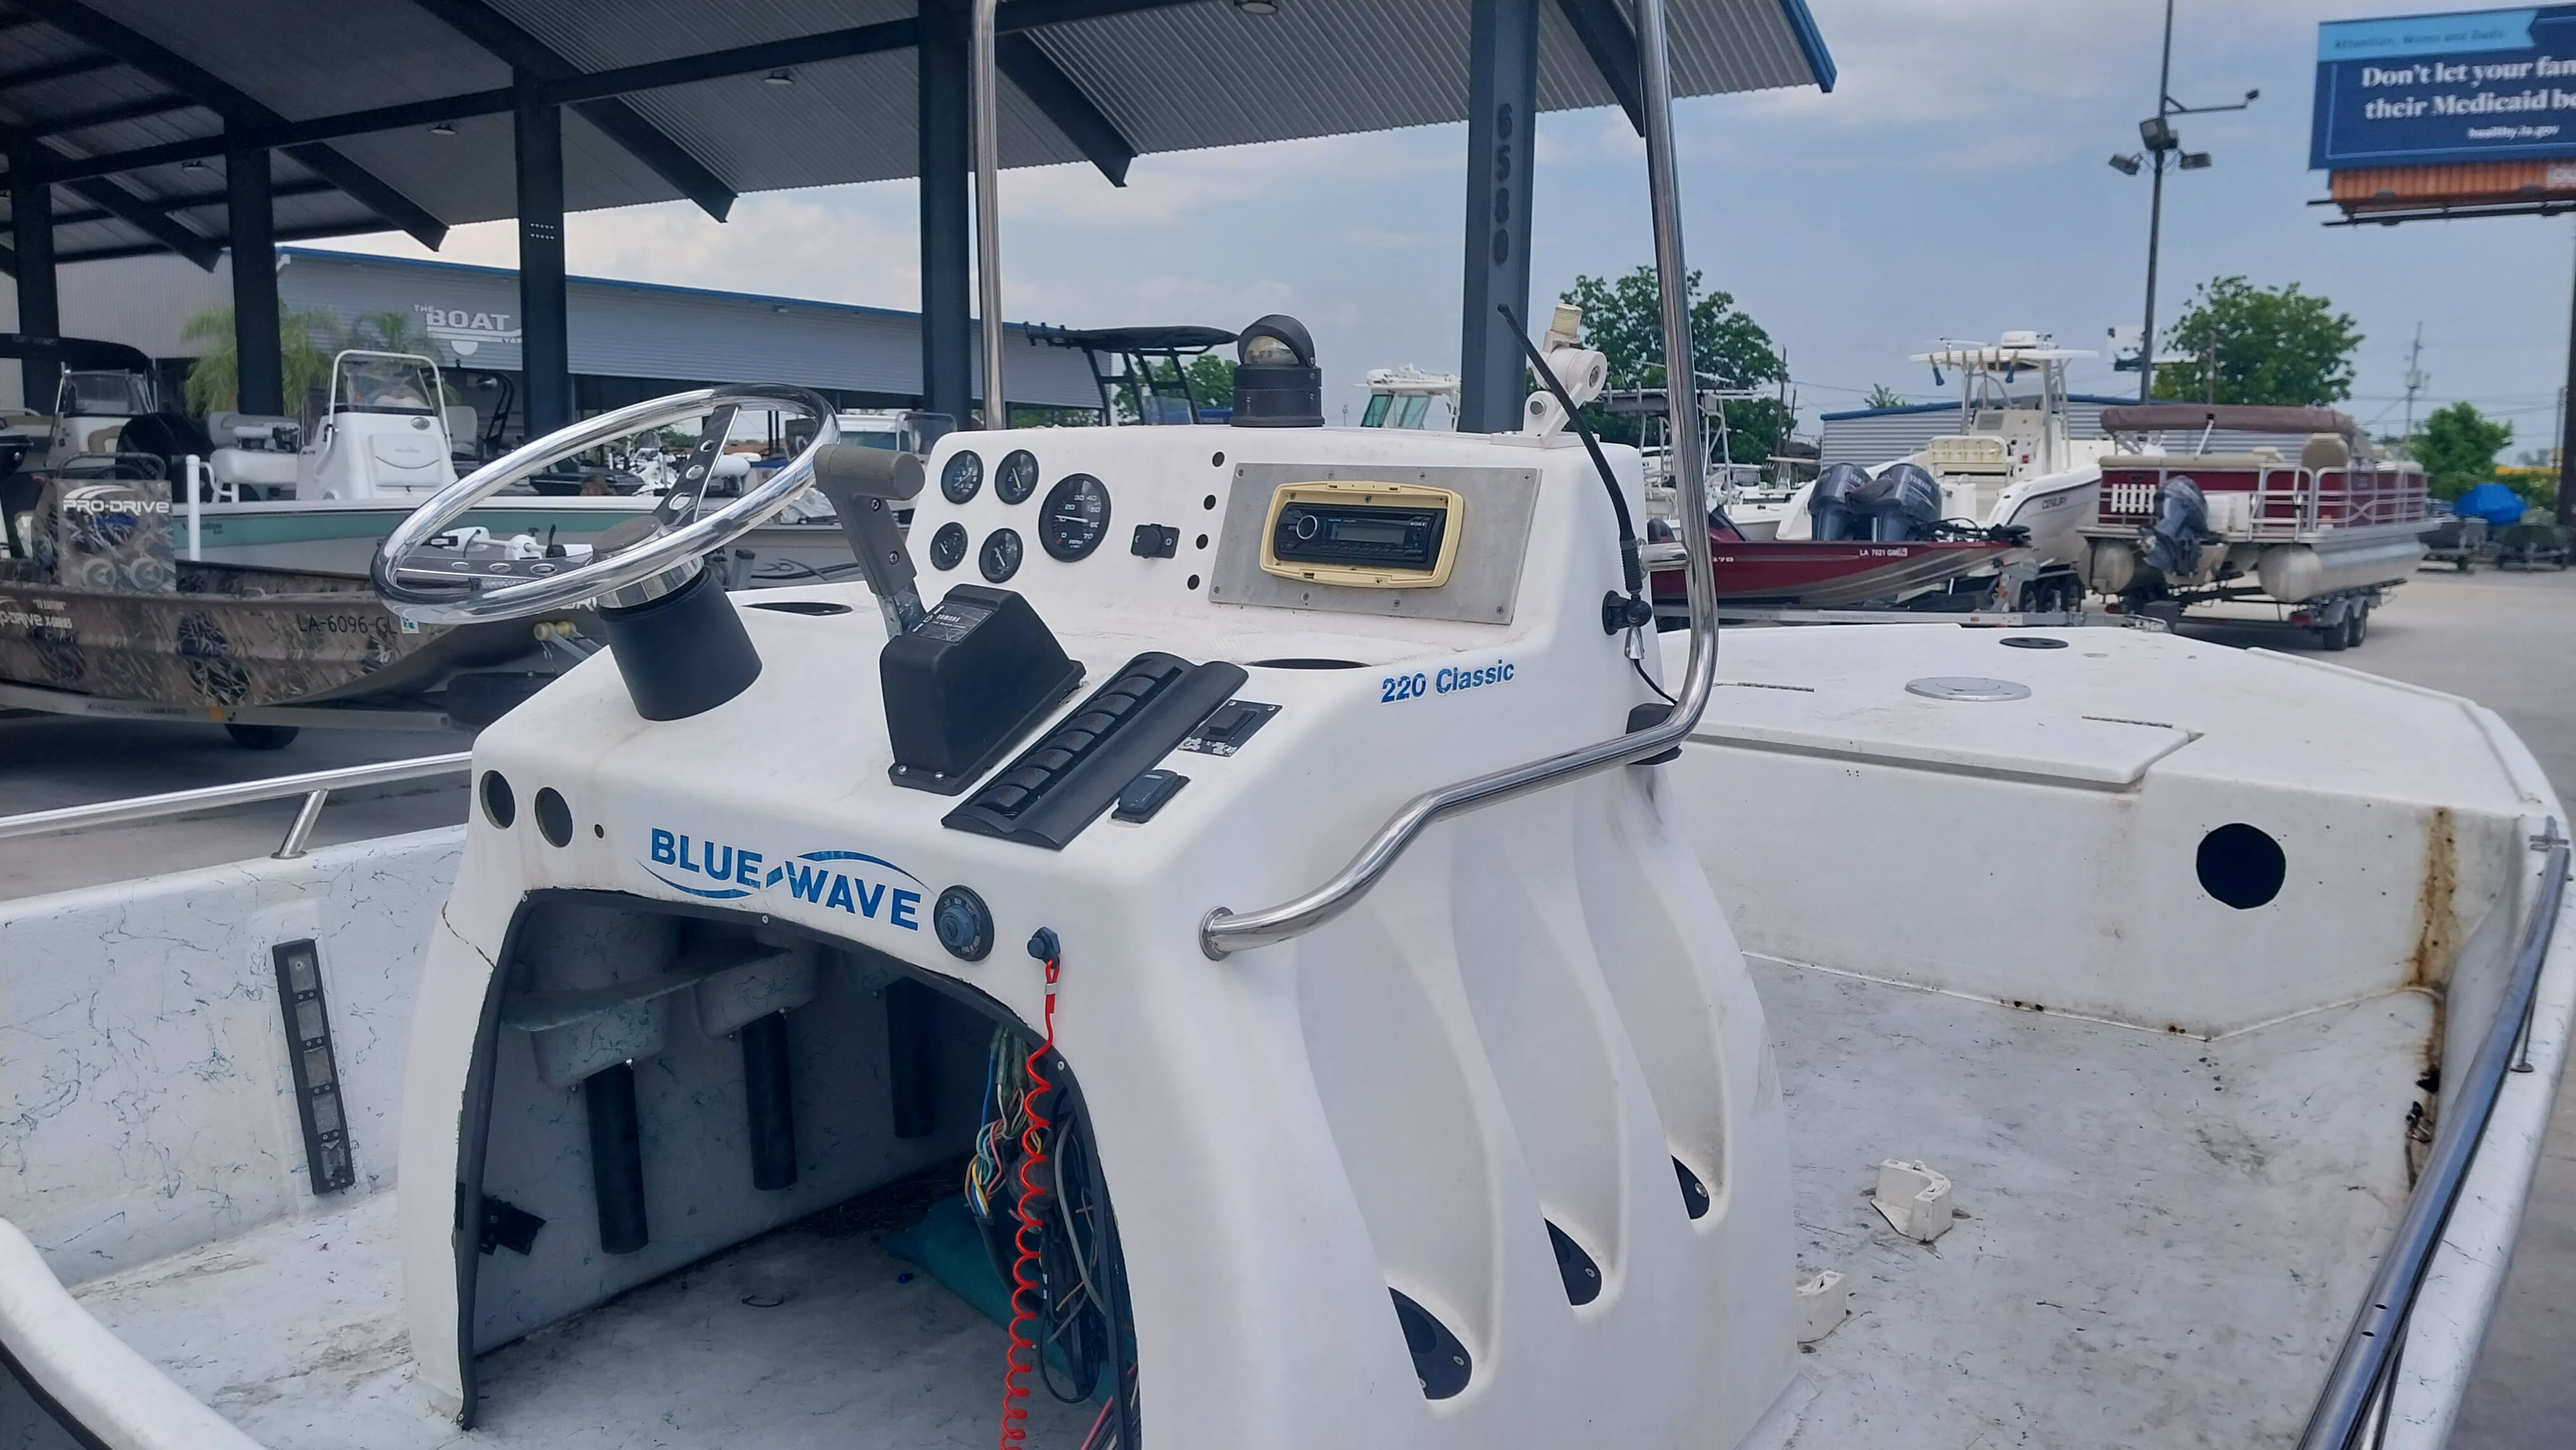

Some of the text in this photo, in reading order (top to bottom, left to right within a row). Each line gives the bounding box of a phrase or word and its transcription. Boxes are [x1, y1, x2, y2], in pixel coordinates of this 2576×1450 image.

[2361, 64, 2431, 88] Don't
[2435, 62, 2467, 83] let
[2472, 62, 2533, 89] your
[2365, 88, 2576, 120] their Medicaid be
[414, 304, 434, 313] THE
[426, 309, 510, 330] BOAT
[936, 614, 962, 622] YAMAHA
[1380, 658, 1515, 704] 220 Classic
[651, 827, 921, 931] BLUE WAVE
